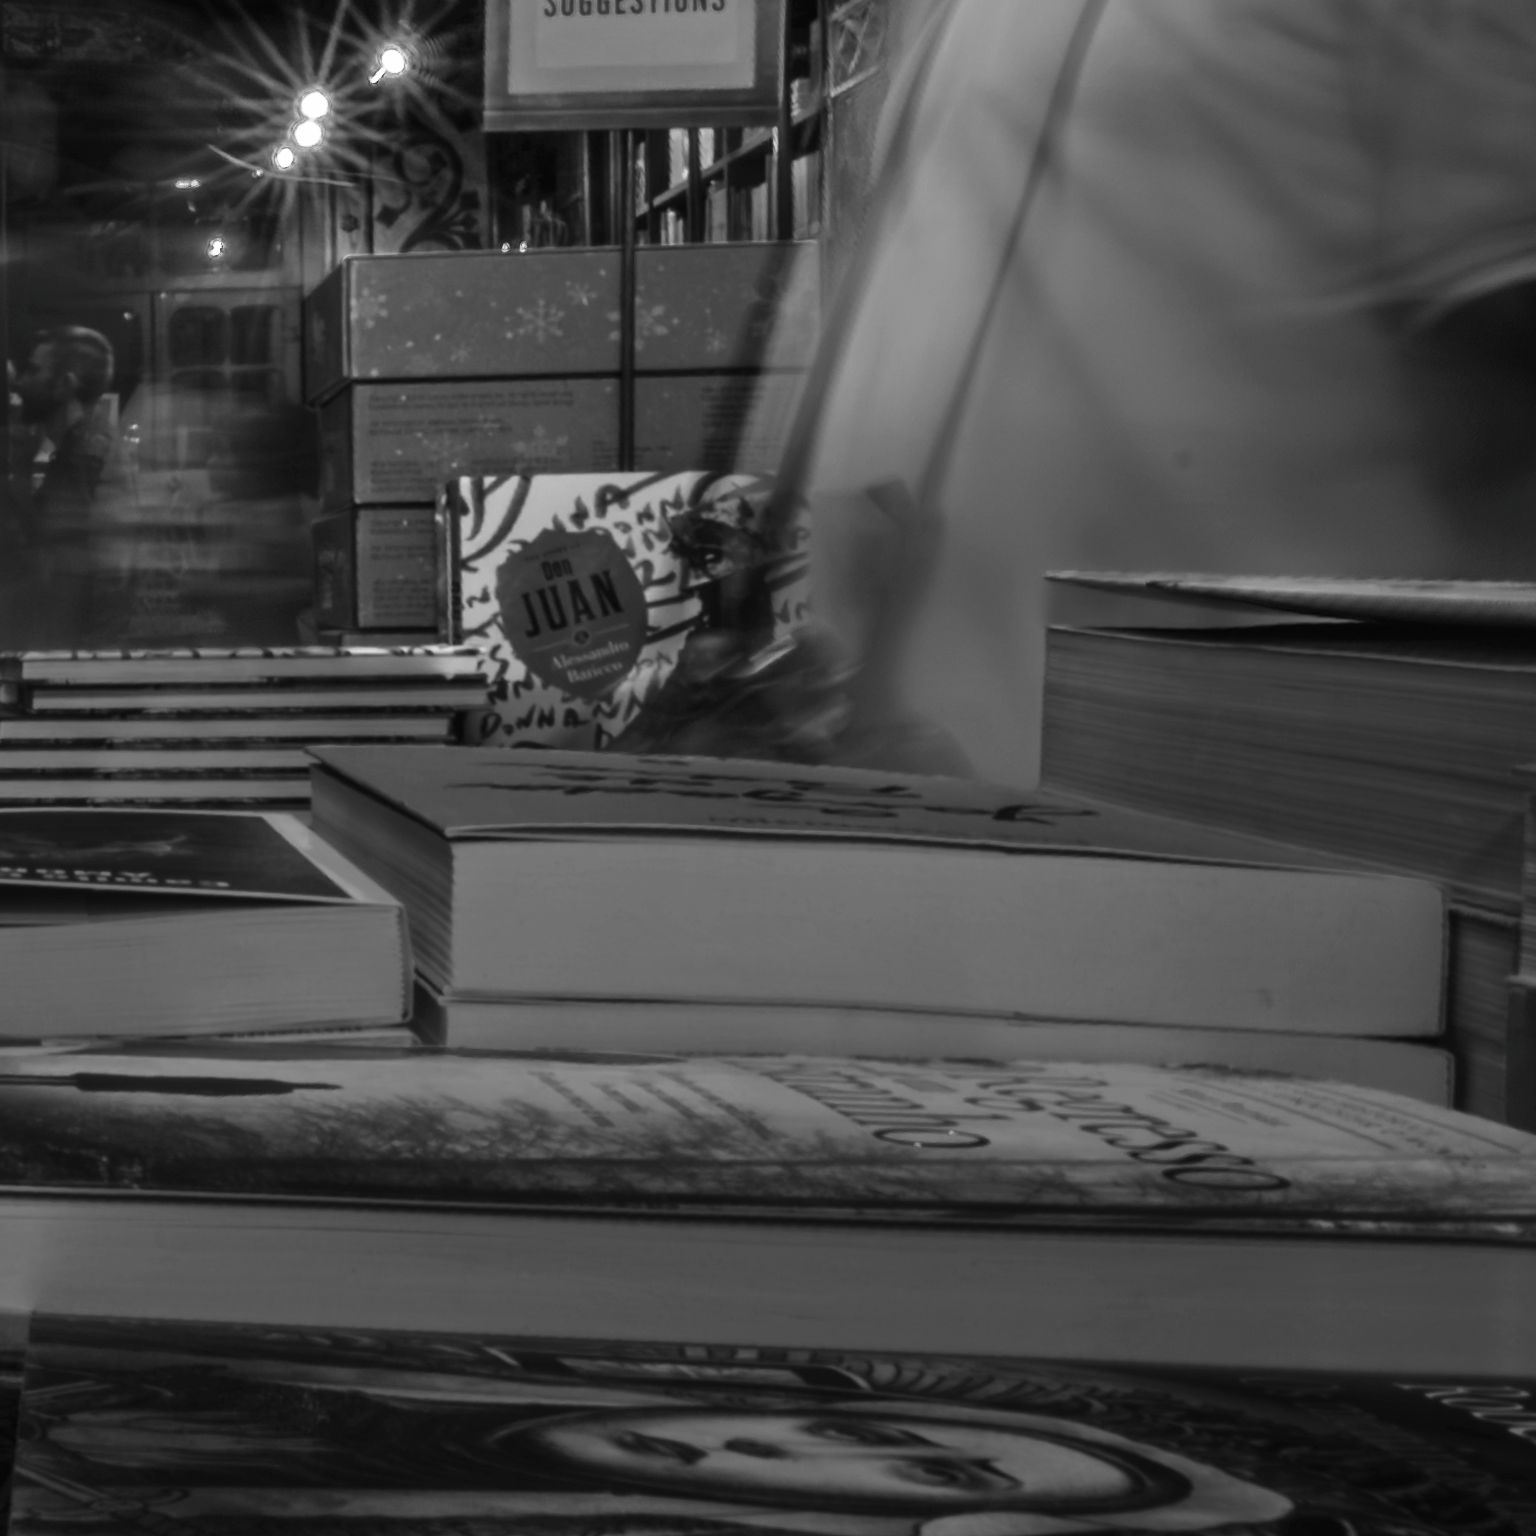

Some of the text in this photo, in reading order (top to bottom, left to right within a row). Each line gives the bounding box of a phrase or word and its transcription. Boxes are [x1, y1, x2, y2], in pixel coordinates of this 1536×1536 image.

[521, 570, 622, 638] JUAN
[552, 640, 630, 670] Alessandro
[567, 662, 622, 683] Baricco
